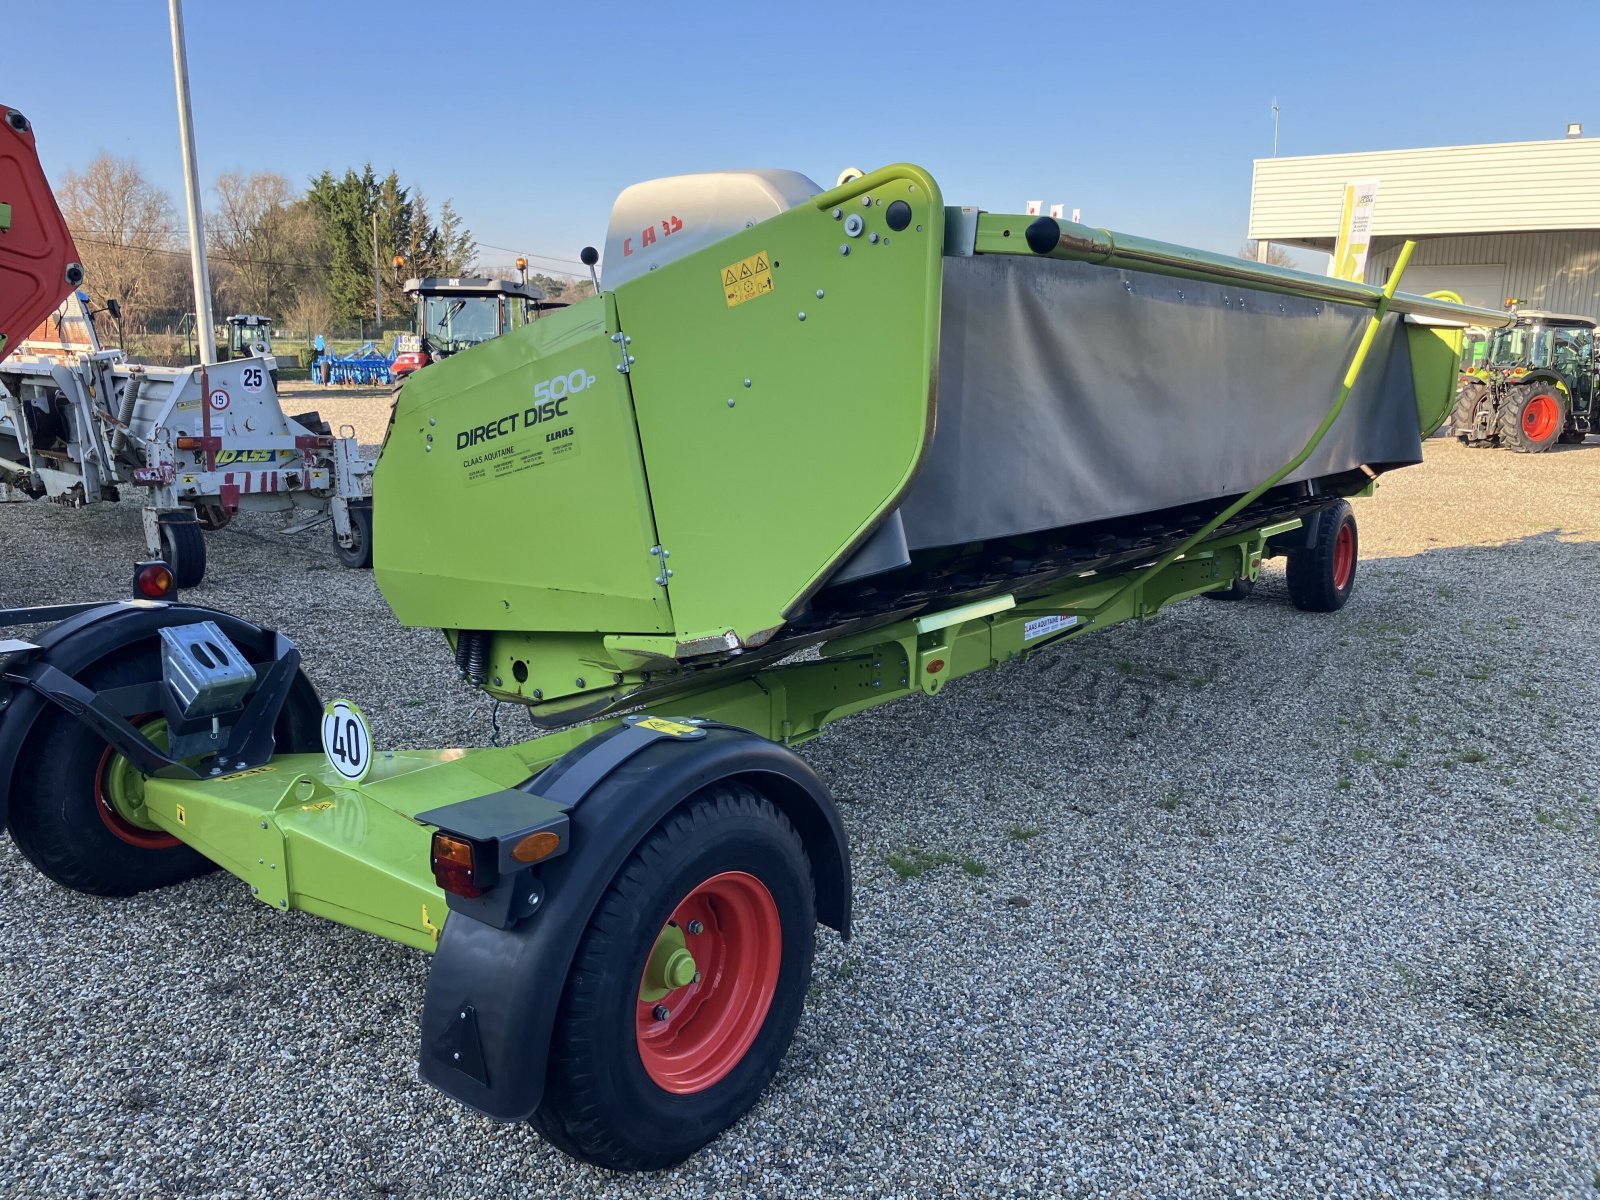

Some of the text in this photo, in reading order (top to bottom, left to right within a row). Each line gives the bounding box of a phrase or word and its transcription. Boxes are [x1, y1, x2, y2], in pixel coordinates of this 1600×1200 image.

[244, 368, 262, 387] 25
[215, 395, 224, 405] 15
[456, 396, 569, 450] DIRECT DISC
[546, 426, 575, 443] CLAAS
[463, 456, 484, 469] CLAAS
[483, 445, 515, 462] AQUITAINE
[332, 717, 361, 766] 40
